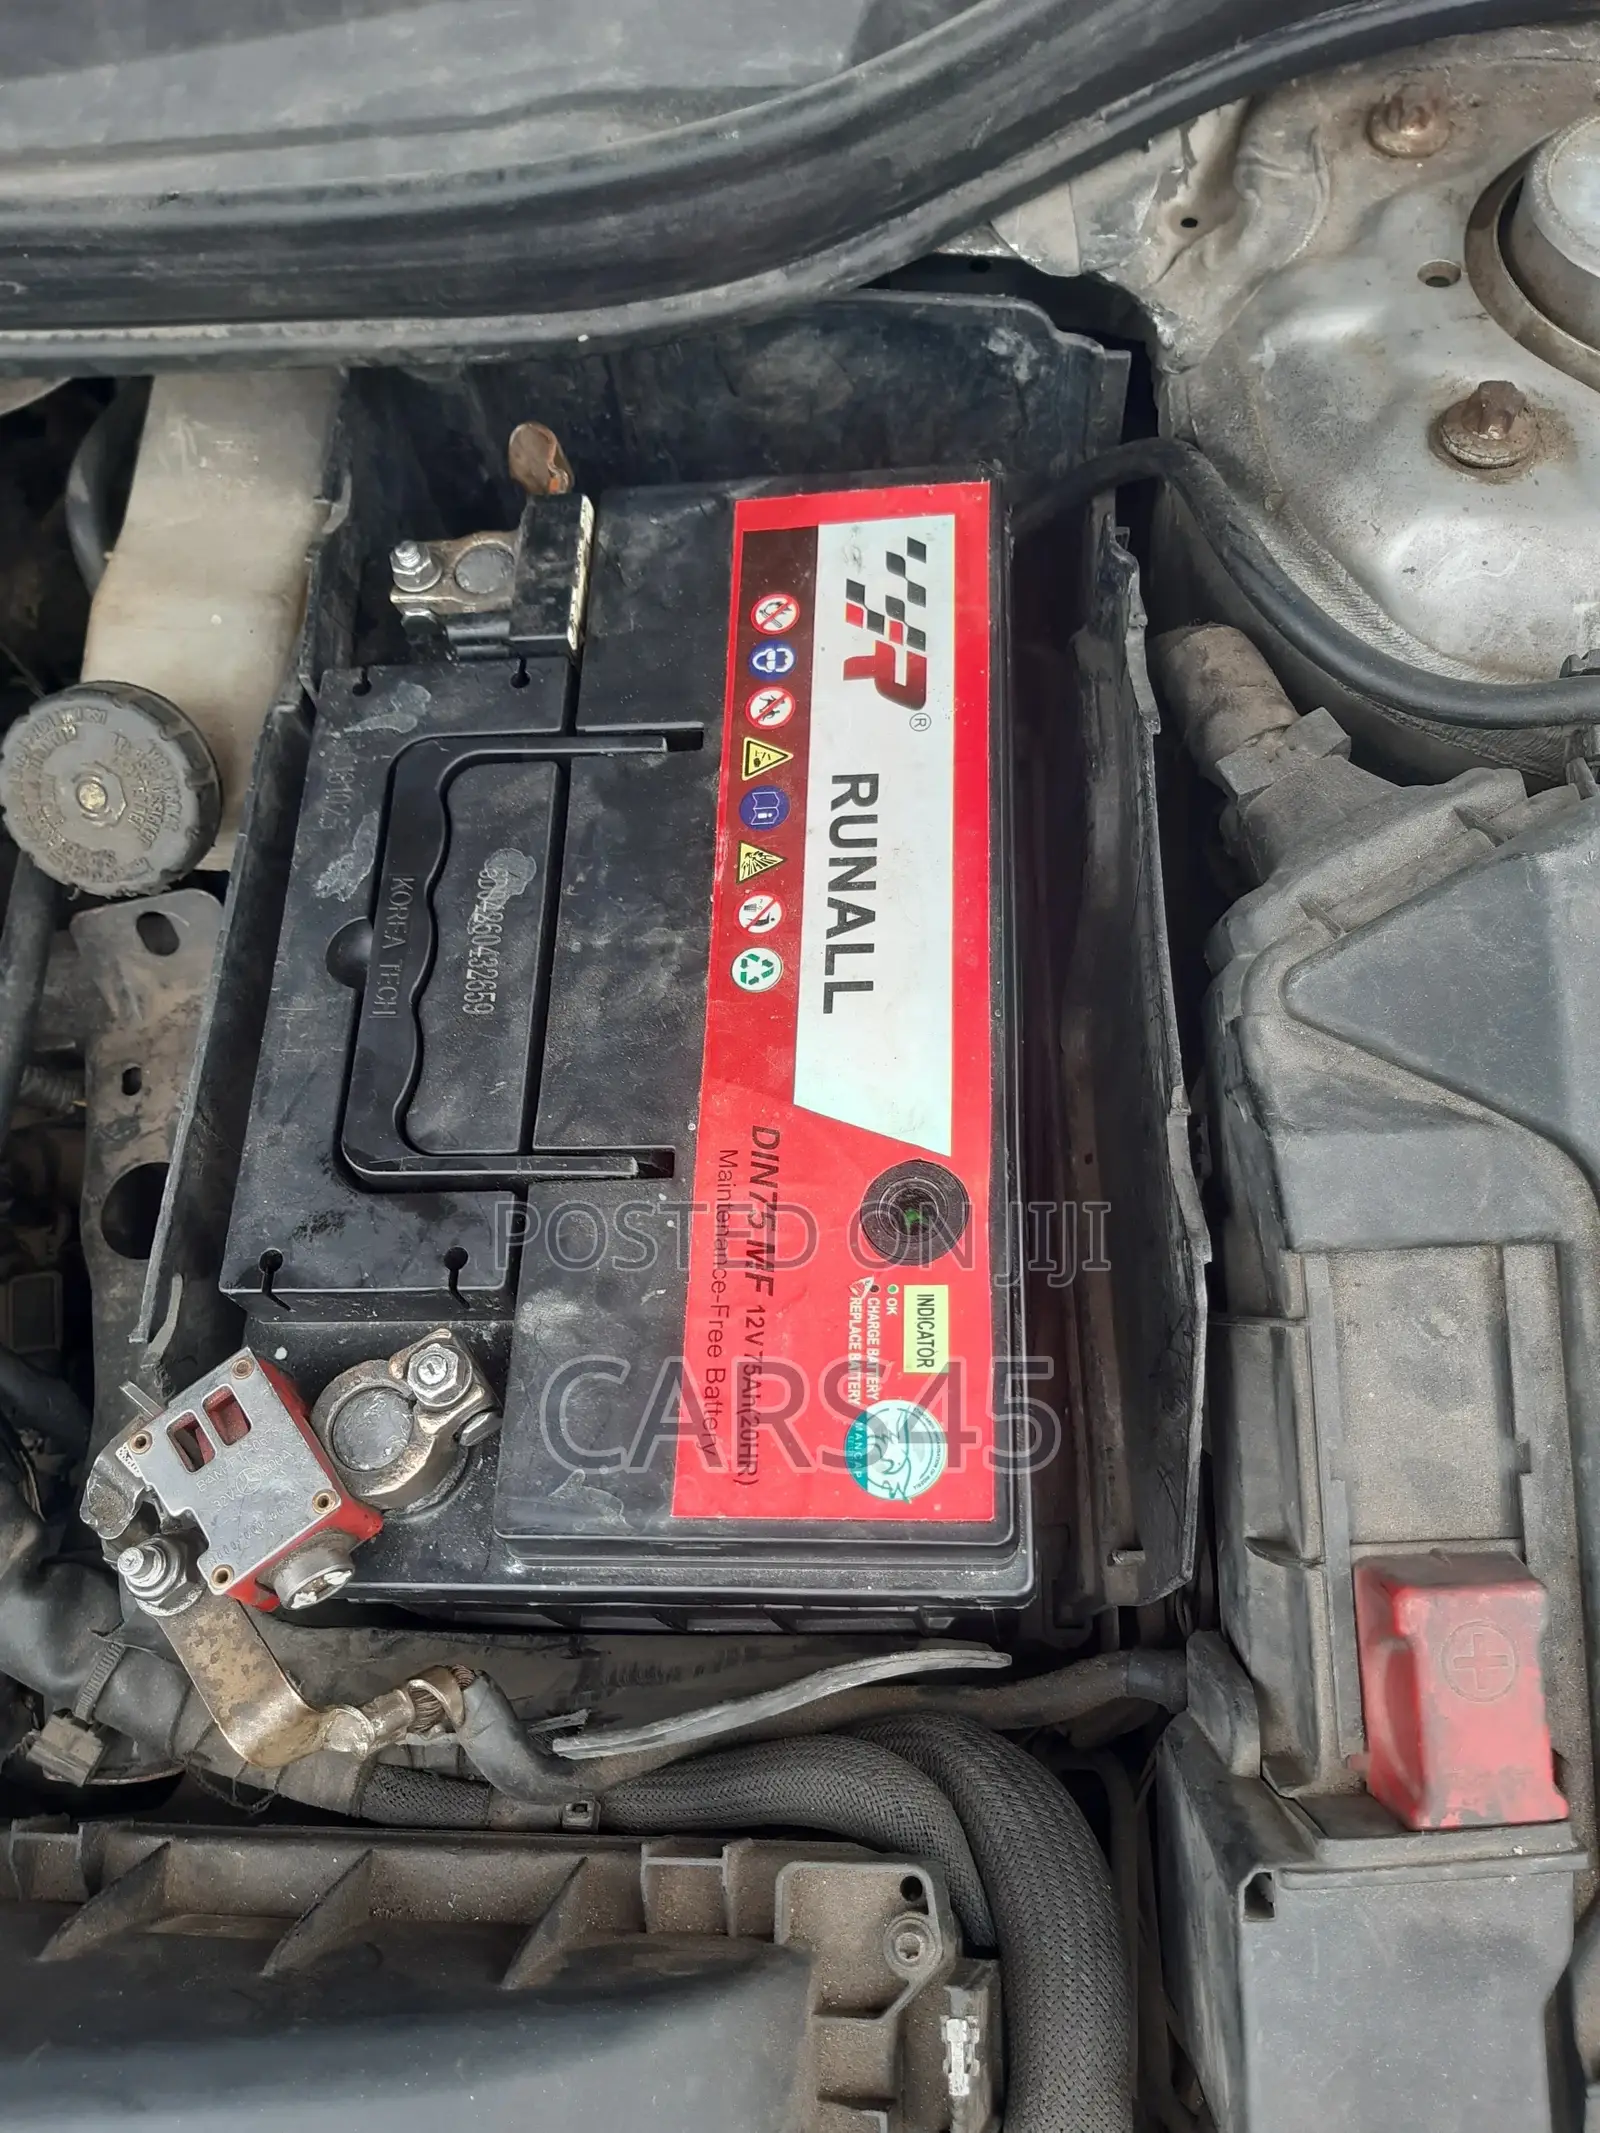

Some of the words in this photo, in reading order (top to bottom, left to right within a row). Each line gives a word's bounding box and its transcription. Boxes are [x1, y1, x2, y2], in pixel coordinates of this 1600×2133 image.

[382, 876, 416, 950] KOREA
[822, 772, 881, 1016] RUNALL
[369, 959, 403, 1019] TECH
[747, 1124, 781, 1231] DIN75
[706, 1148, 738, 1359] Maintenance-Free
[743, 1239, 775, 1297] MF
[847, 1297, 863, 1350] REPLACE
[866, 1297, 881, 1347] CHARGE
[886, 1297, 898, 1316] OK
[916, 1293, 936, 1368] INDICATOR
[846, 1353, 862, 1406] BATTERY
[865, 1349, 880, 1401] BATTERY
[695, 1367, 726, 1457] Battery
[853, 1421, 864, 1479] MANCAP
